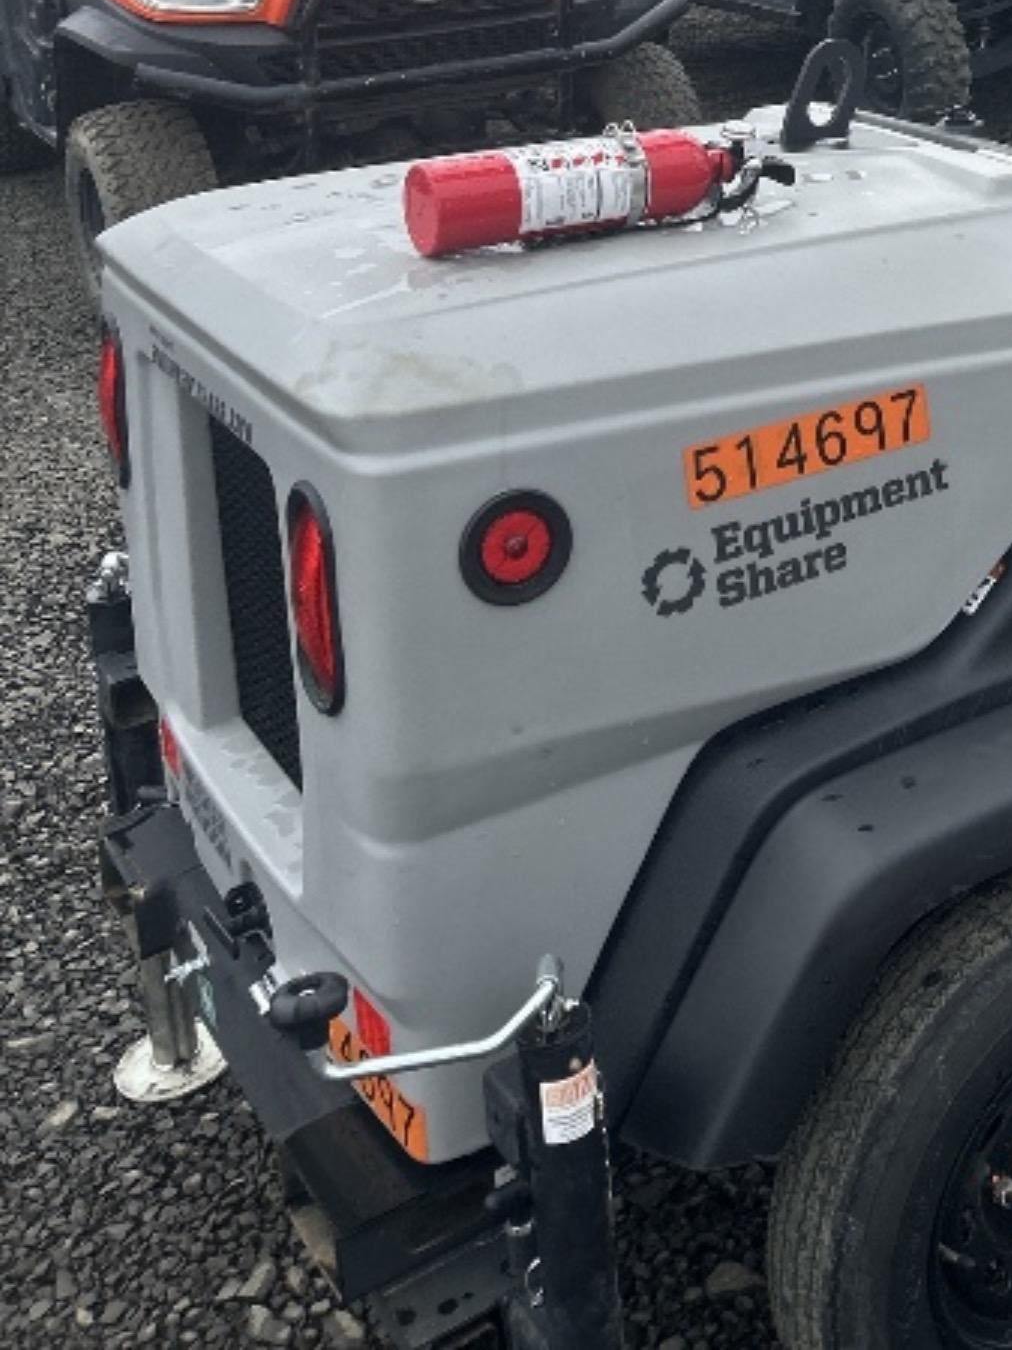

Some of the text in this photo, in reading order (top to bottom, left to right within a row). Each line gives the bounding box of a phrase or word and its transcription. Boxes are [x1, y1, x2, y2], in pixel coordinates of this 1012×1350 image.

[692, 389, 918, 503] 514697
[711, 457, 949, 564] Equipment
[715, 541, 848, 609] Share
